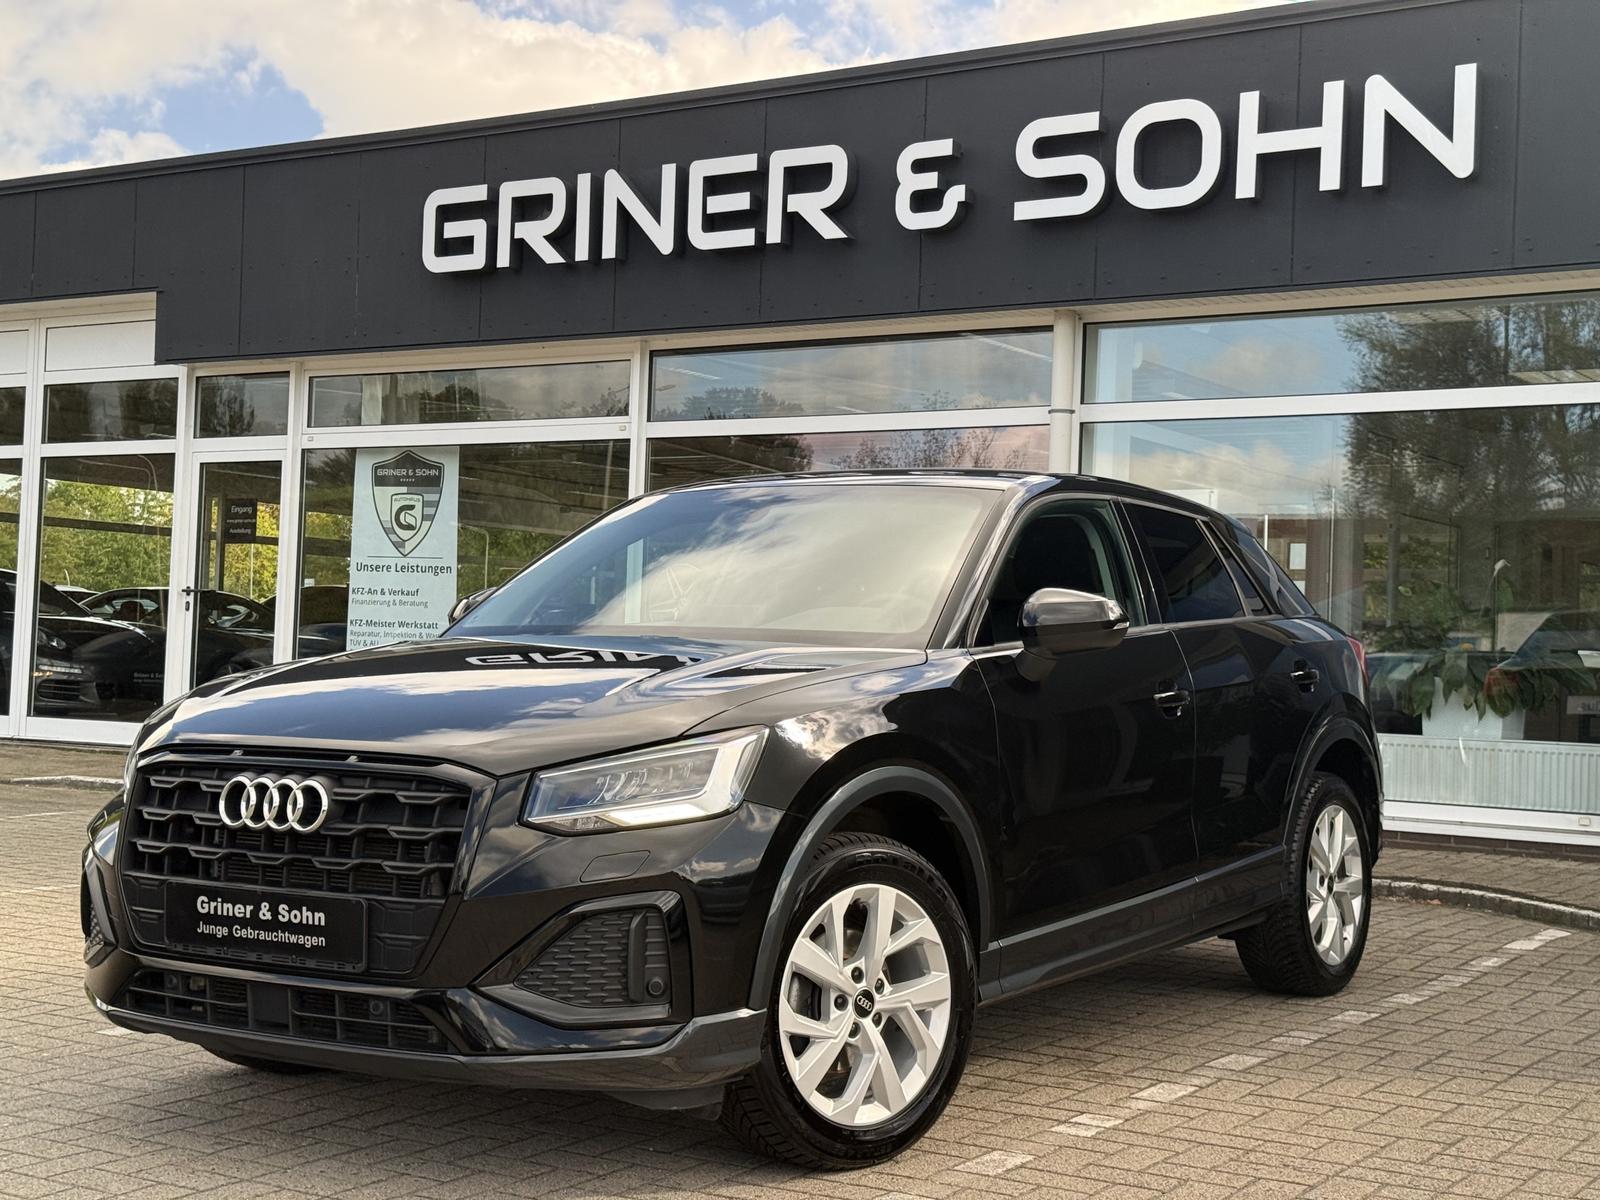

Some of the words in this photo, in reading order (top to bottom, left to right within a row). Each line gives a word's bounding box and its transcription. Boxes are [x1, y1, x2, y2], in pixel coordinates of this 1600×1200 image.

[422, 144, 850, 274] GRINER
[895, 138, 966, 231] &
[1013, 62, 1477, 221] SOHN
[376, 468, 407, 477] GRINER
[408, 468, 414, 477] &
[415, 468, 439, 477] SOHN
[231, 505, 253, 515] Eingang
[356, 562, 392, 574] Unsere
[394, 563, 452, 576] Leistungen
[351, 587, 378, 596] KFZ-An
[379, 588, 386, 596] &
[388, 588, 420, 597] Verkauf
[351, 598, 391, 608] Finanzierung
[392, 599, 397, 607] &
[398, 599, 429, 609] Beratung
[349, 619, 396, 628] KFZ-Meister
[397, 620, 439, 630] Werkstatt
[349, 629, 382, 639] Reparatur,
[383, 630, 417, 640] Inspektion
[362, 639, 368, 648] &
[196, 895, 254, 919] Griner
[258, 901, 273, 921] &
[277, 904, 326, 926] Sohn
[196, 921, 229, 939] Junge
[232, 925, 326, 948] Gebrauchtwagen
